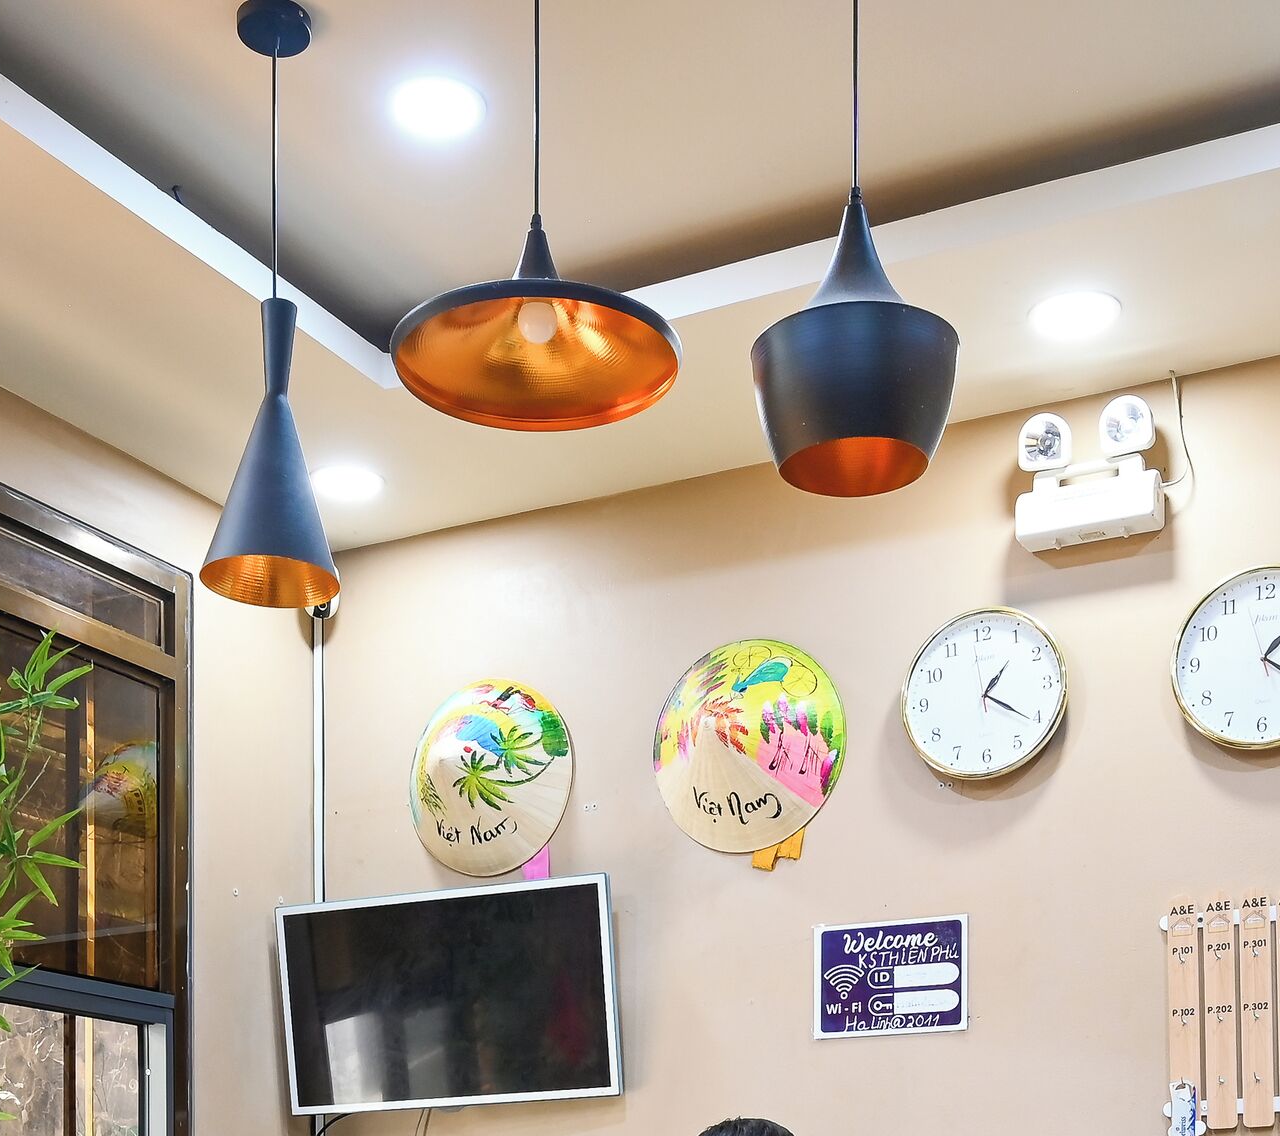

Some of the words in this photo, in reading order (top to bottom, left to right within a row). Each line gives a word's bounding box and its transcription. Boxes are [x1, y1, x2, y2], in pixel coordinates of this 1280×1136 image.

[1255, 582, 1276, 601] 12
[1221, 599, 1237, 616] 11
[1199, 625, 1218, 643] 10
[1189, 657, 1201, 674] 9
[1201, 690, 1213, 707] 8
[1224, 711, 1235, 728] 7
[1256, 716, 1268, 733] 6
[1206, 901, 1231, 912] A&E
[1242, 897, 1267, 908] A&E
[1170, 905, 1195, 916] A&E
[843, 930, 938, 954] Welcome
[1207, 942, 1231, 953] P.201
[1243, 938, 1267, 949] P.301
[1172, 946, 1194, 956] P.101
[874, 972, 890, 983] ID
[1172, 1007, 1195, 1017] P.102
[1207, 1004, 1233, 1015] P.202
[1243, 1002, 1269, 1012] P.302
